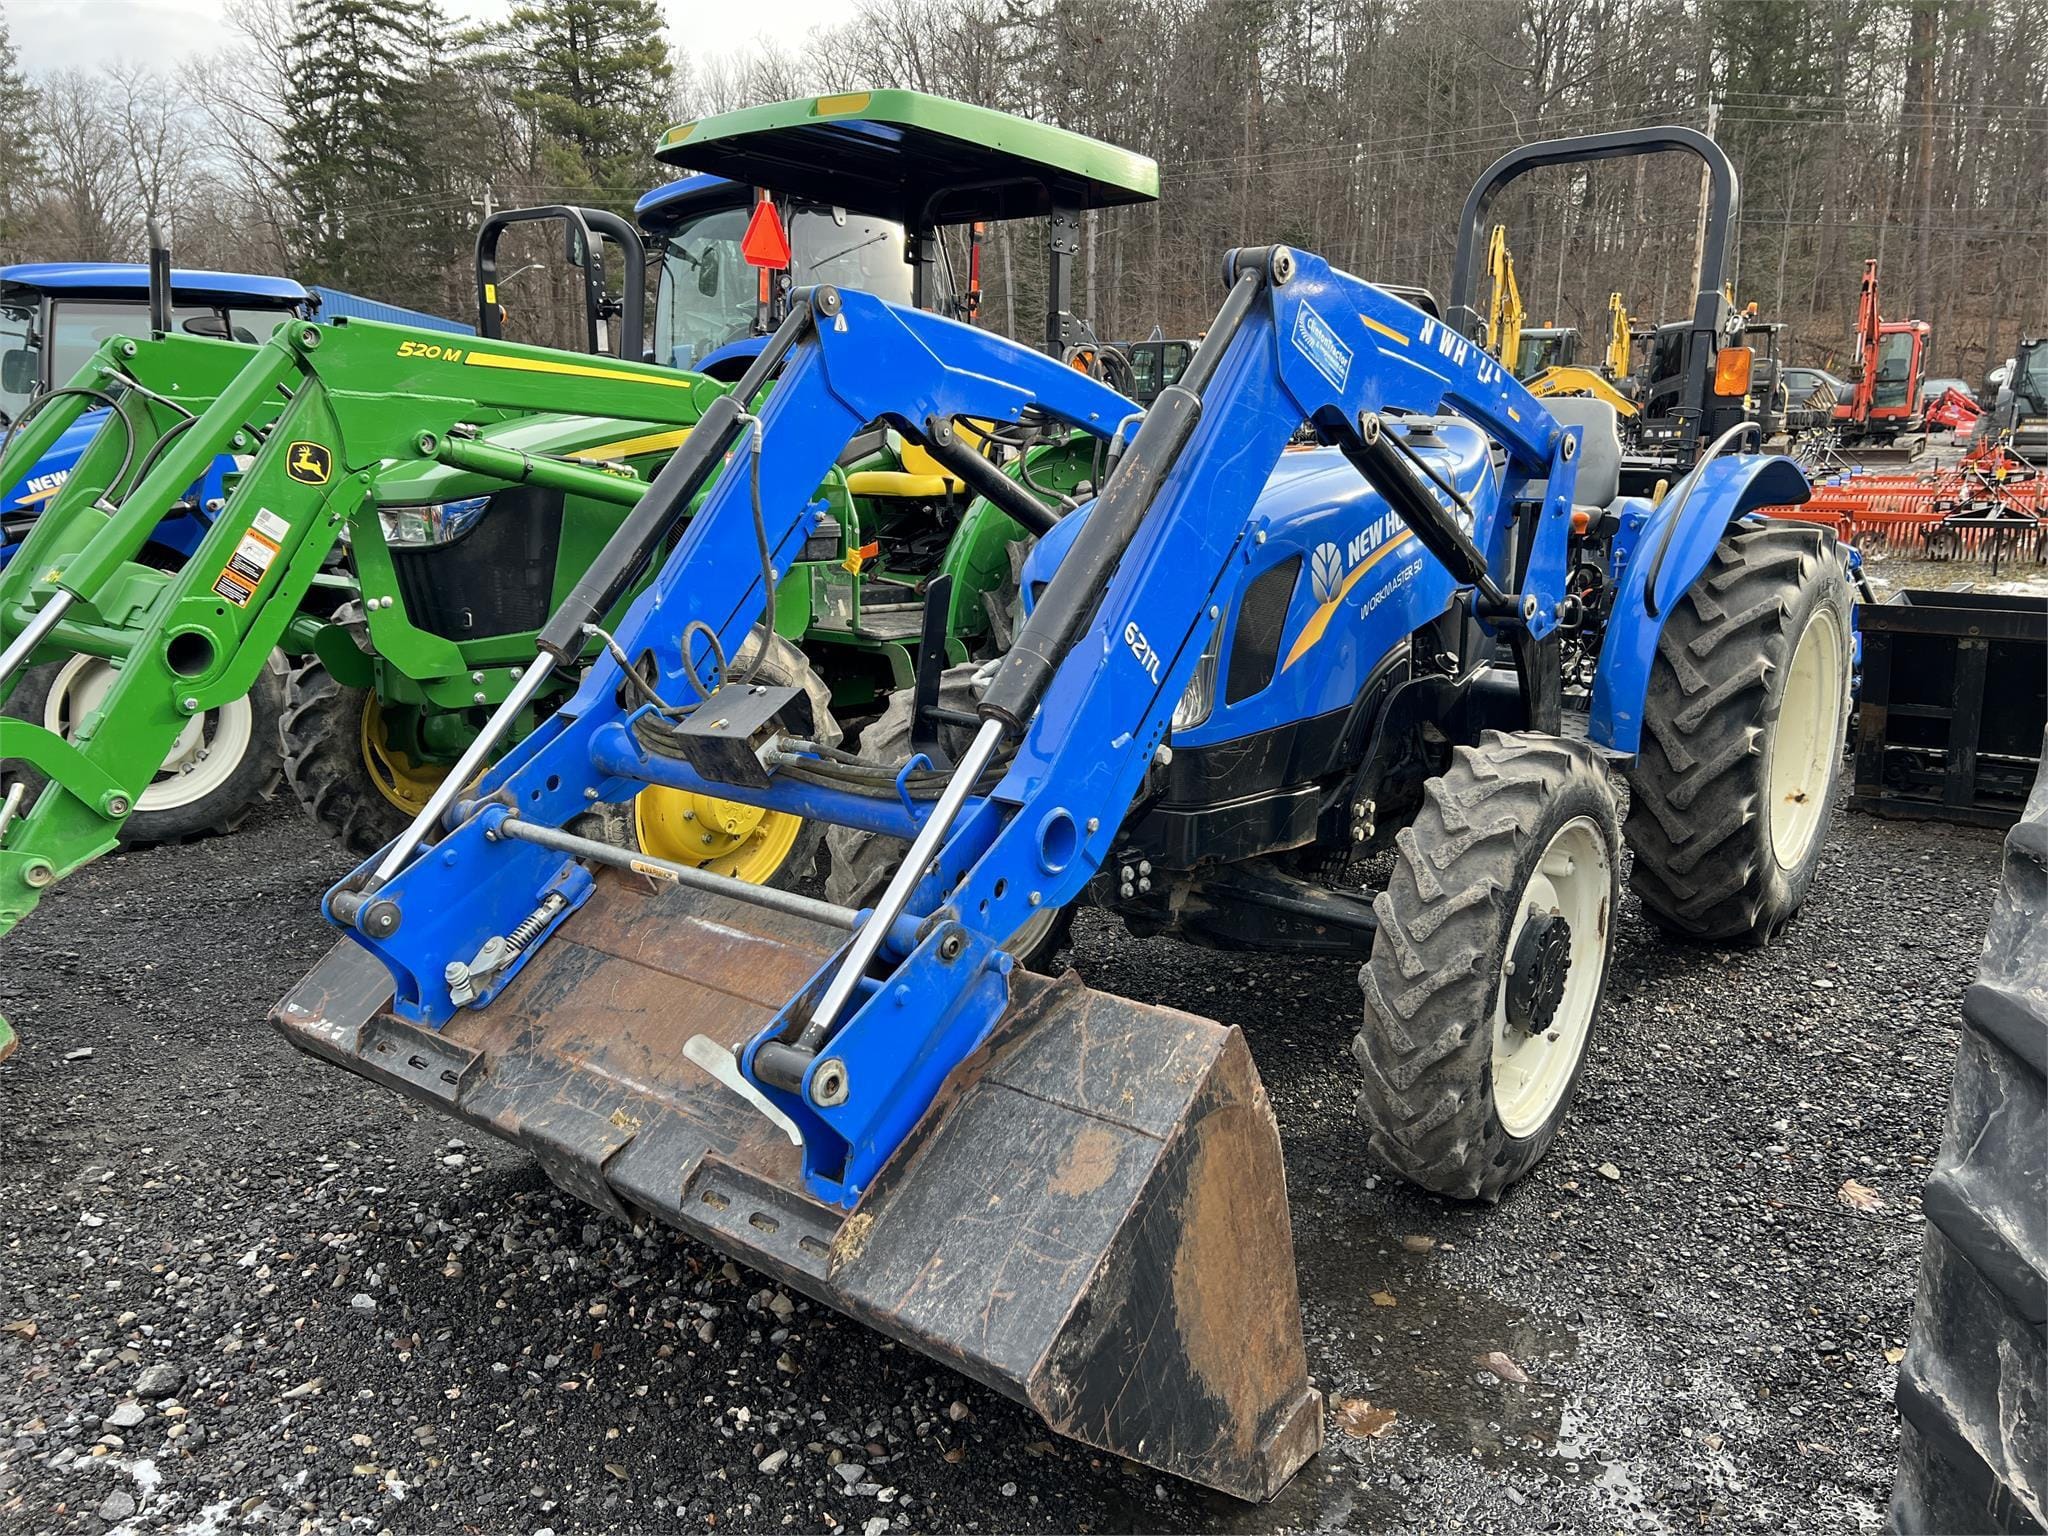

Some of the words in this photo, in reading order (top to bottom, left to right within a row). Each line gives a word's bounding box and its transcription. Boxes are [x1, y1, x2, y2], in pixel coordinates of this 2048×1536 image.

[397, 341, 442, 359] 520
[442, 348, 463, 362] M
[1532, 384, 1557, 399] OLLAND
[26, 469, 70, 494] NEW
[1348, 516, 1384, 569] NEW
[1360, 564, 1414, 620] WORKMASTER
[1413, 558, 1423, 574] 50
[1124, 621, 1160, 685] 621TL
